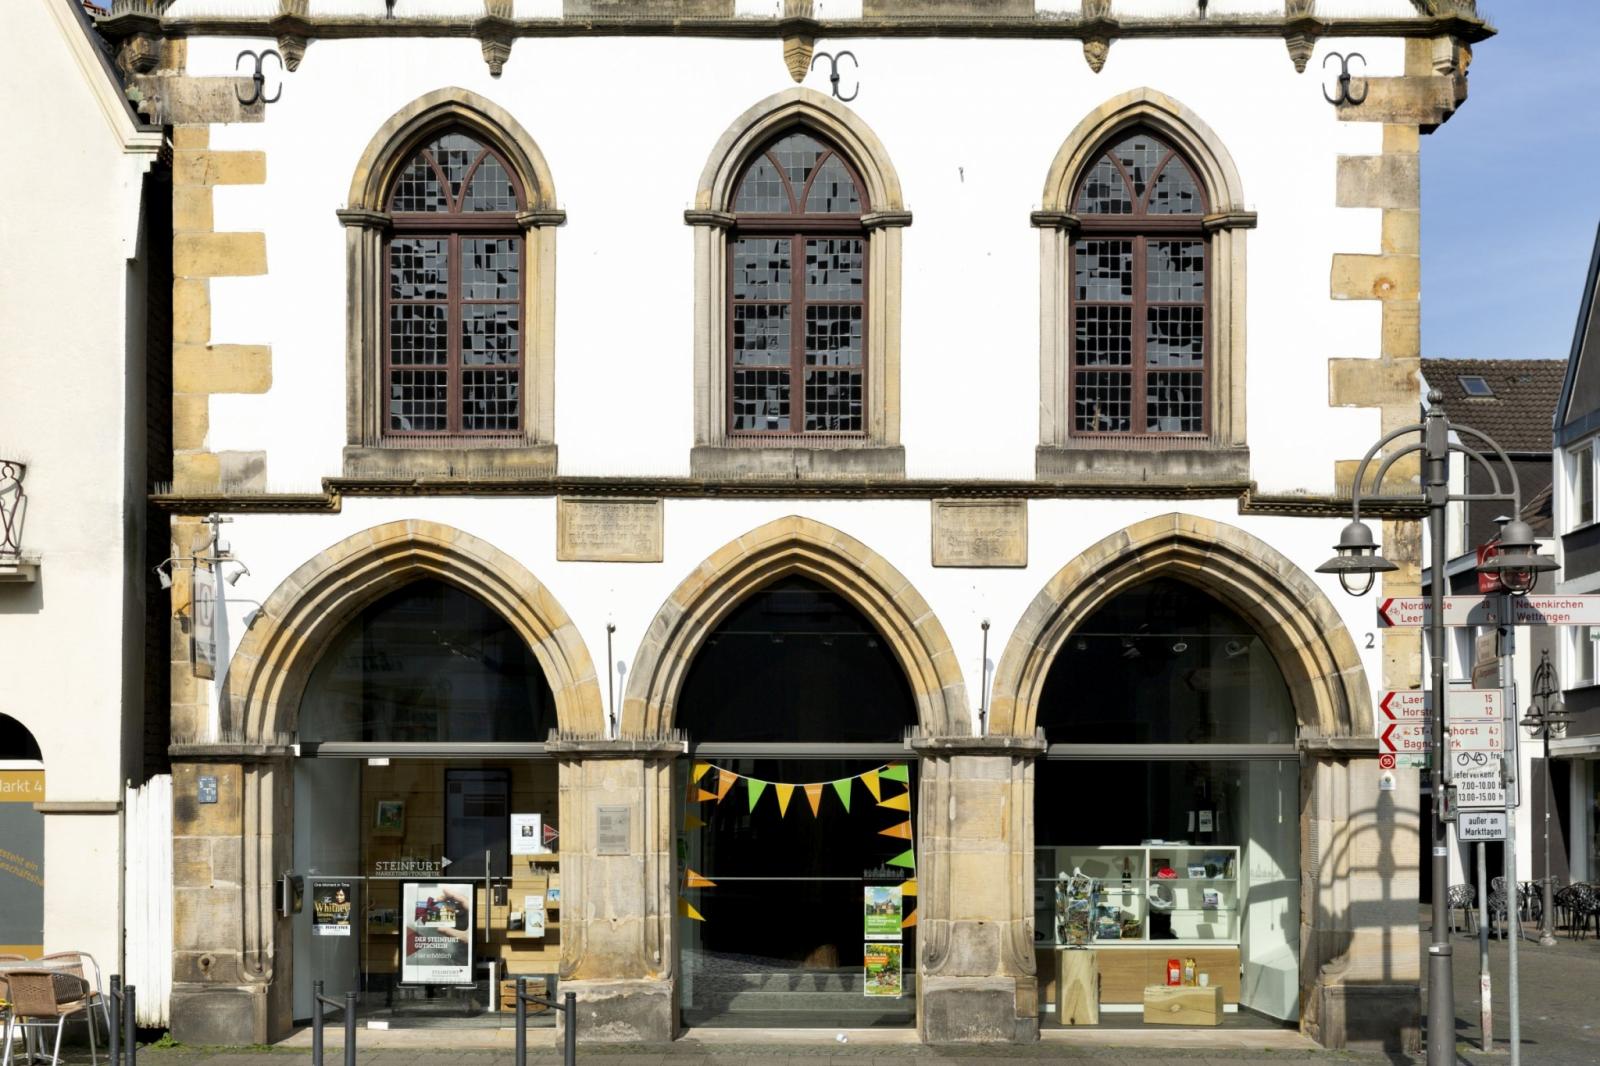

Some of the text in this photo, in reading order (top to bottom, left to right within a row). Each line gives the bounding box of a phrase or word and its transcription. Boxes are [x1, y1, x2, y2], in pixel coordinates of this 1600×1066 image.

[1401, 602, 1452, 610] Nordwde
[1516, 600, 1583, 608] Neuenkirchen
[1517, 613, 1570, 622] Wettringen
[1365, 632, 1375, 649] 2
[1402, 695, 1492, 704] Laer 15
[1402, 707, 1493, 716] Horst 12
[1403, 740, 1461, 750] Bagnork
[0, 779, 42, 793] arkt 4
[1469, 816, 1487, 825] außer
[1465, 828, 1502, 837] Markttagen
[375, 861, 441, 871] STEINFURT
[314, 901, 349, 913] Whitney
